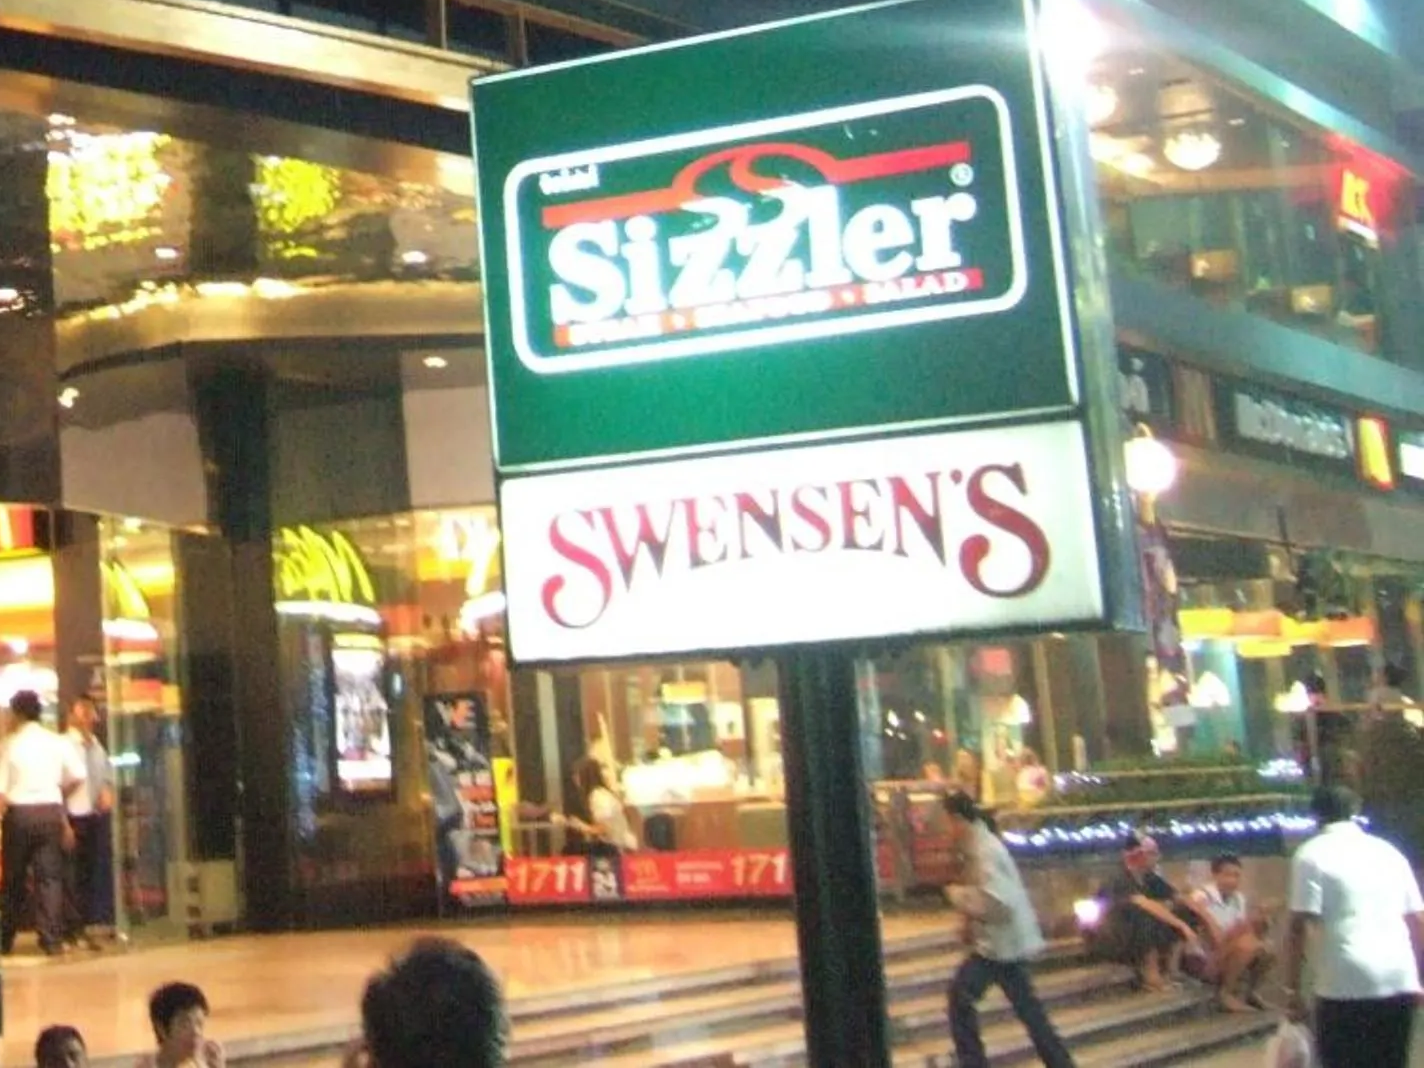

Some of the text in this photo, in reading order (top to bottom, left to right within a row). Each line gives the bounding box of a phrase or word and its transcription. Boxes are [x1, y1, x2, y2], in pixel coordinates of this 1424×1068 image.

[548, 181, 978, 327] Sizzler
[541, 462, 1051, 630] SWENSEN'S
[516, 860, 586, 893] 1711
